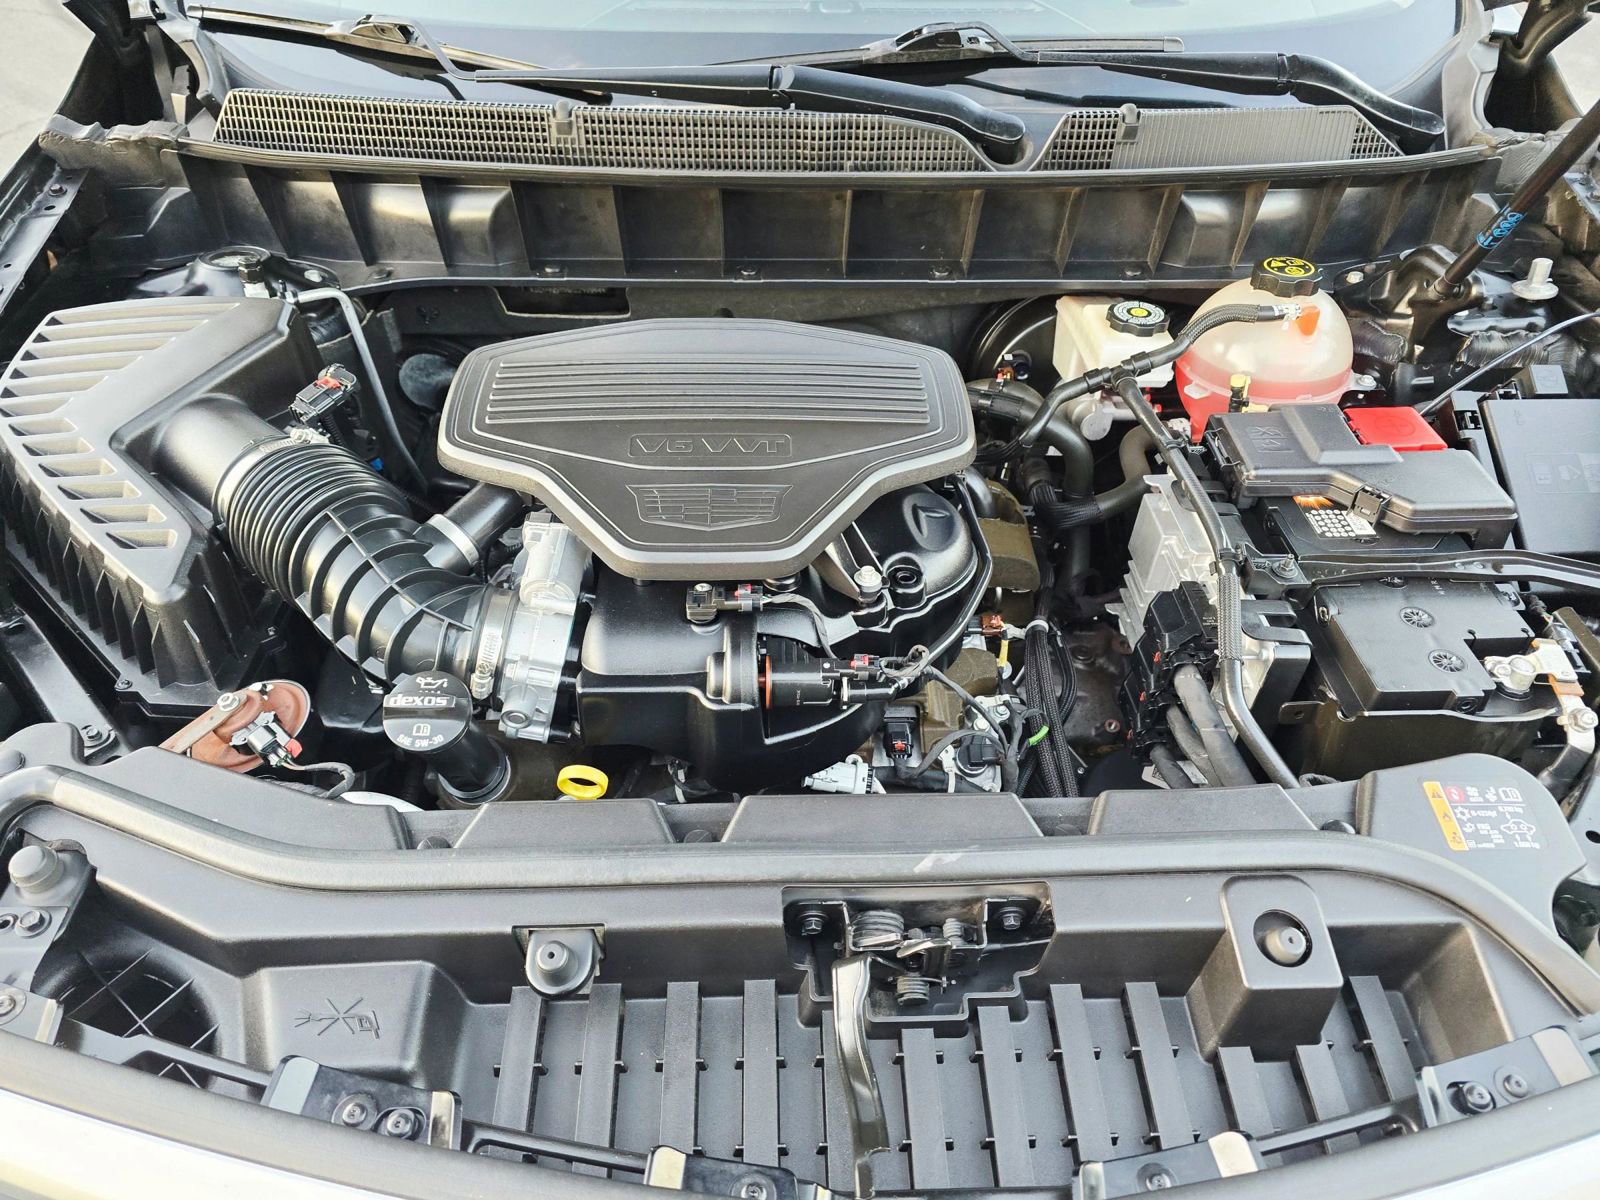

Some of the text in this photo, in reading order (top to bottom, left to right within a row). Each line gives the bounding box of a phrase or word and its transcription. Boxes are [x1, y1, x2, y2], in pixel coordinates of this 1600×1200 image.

[636, 437, 785, 453] V6 VVT
[389, 694, 450, 706] dexos
